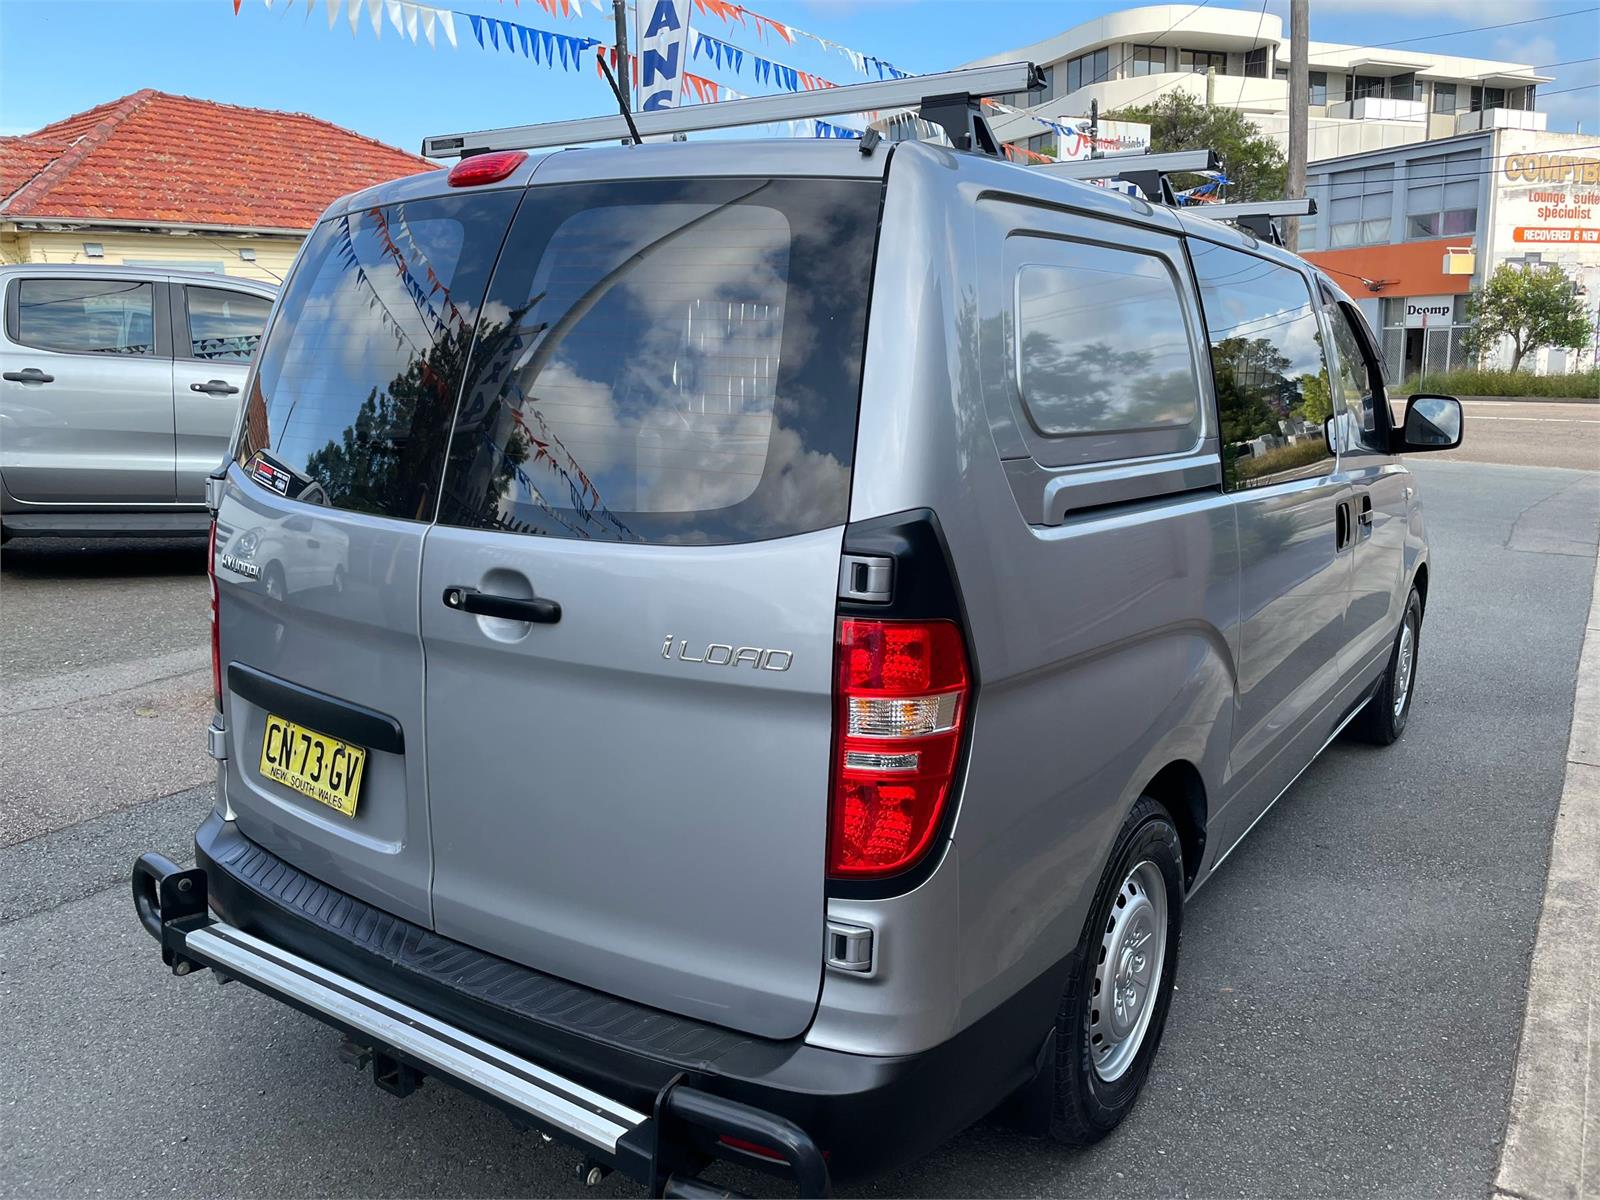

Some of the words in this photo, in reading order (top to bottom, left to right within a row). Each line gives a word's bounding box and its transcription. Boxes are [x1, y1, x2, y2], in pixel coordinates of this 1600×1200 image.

[1504, 154, 1600, 184] COMFYB
[1528, 191, 1566, 207] Lounge
[1537, 205, 1591, 221] specialist
[1524, 230, 1571, 240] RECOVERED
[1582, 231, 1599, 240] NEW
[1407, 305, 1450, 316] Dcomp
[270, 766, 288, 781] NEW
[291, 775, 315, 795] SOUTH
[318, 787, 343, 809] WALES
